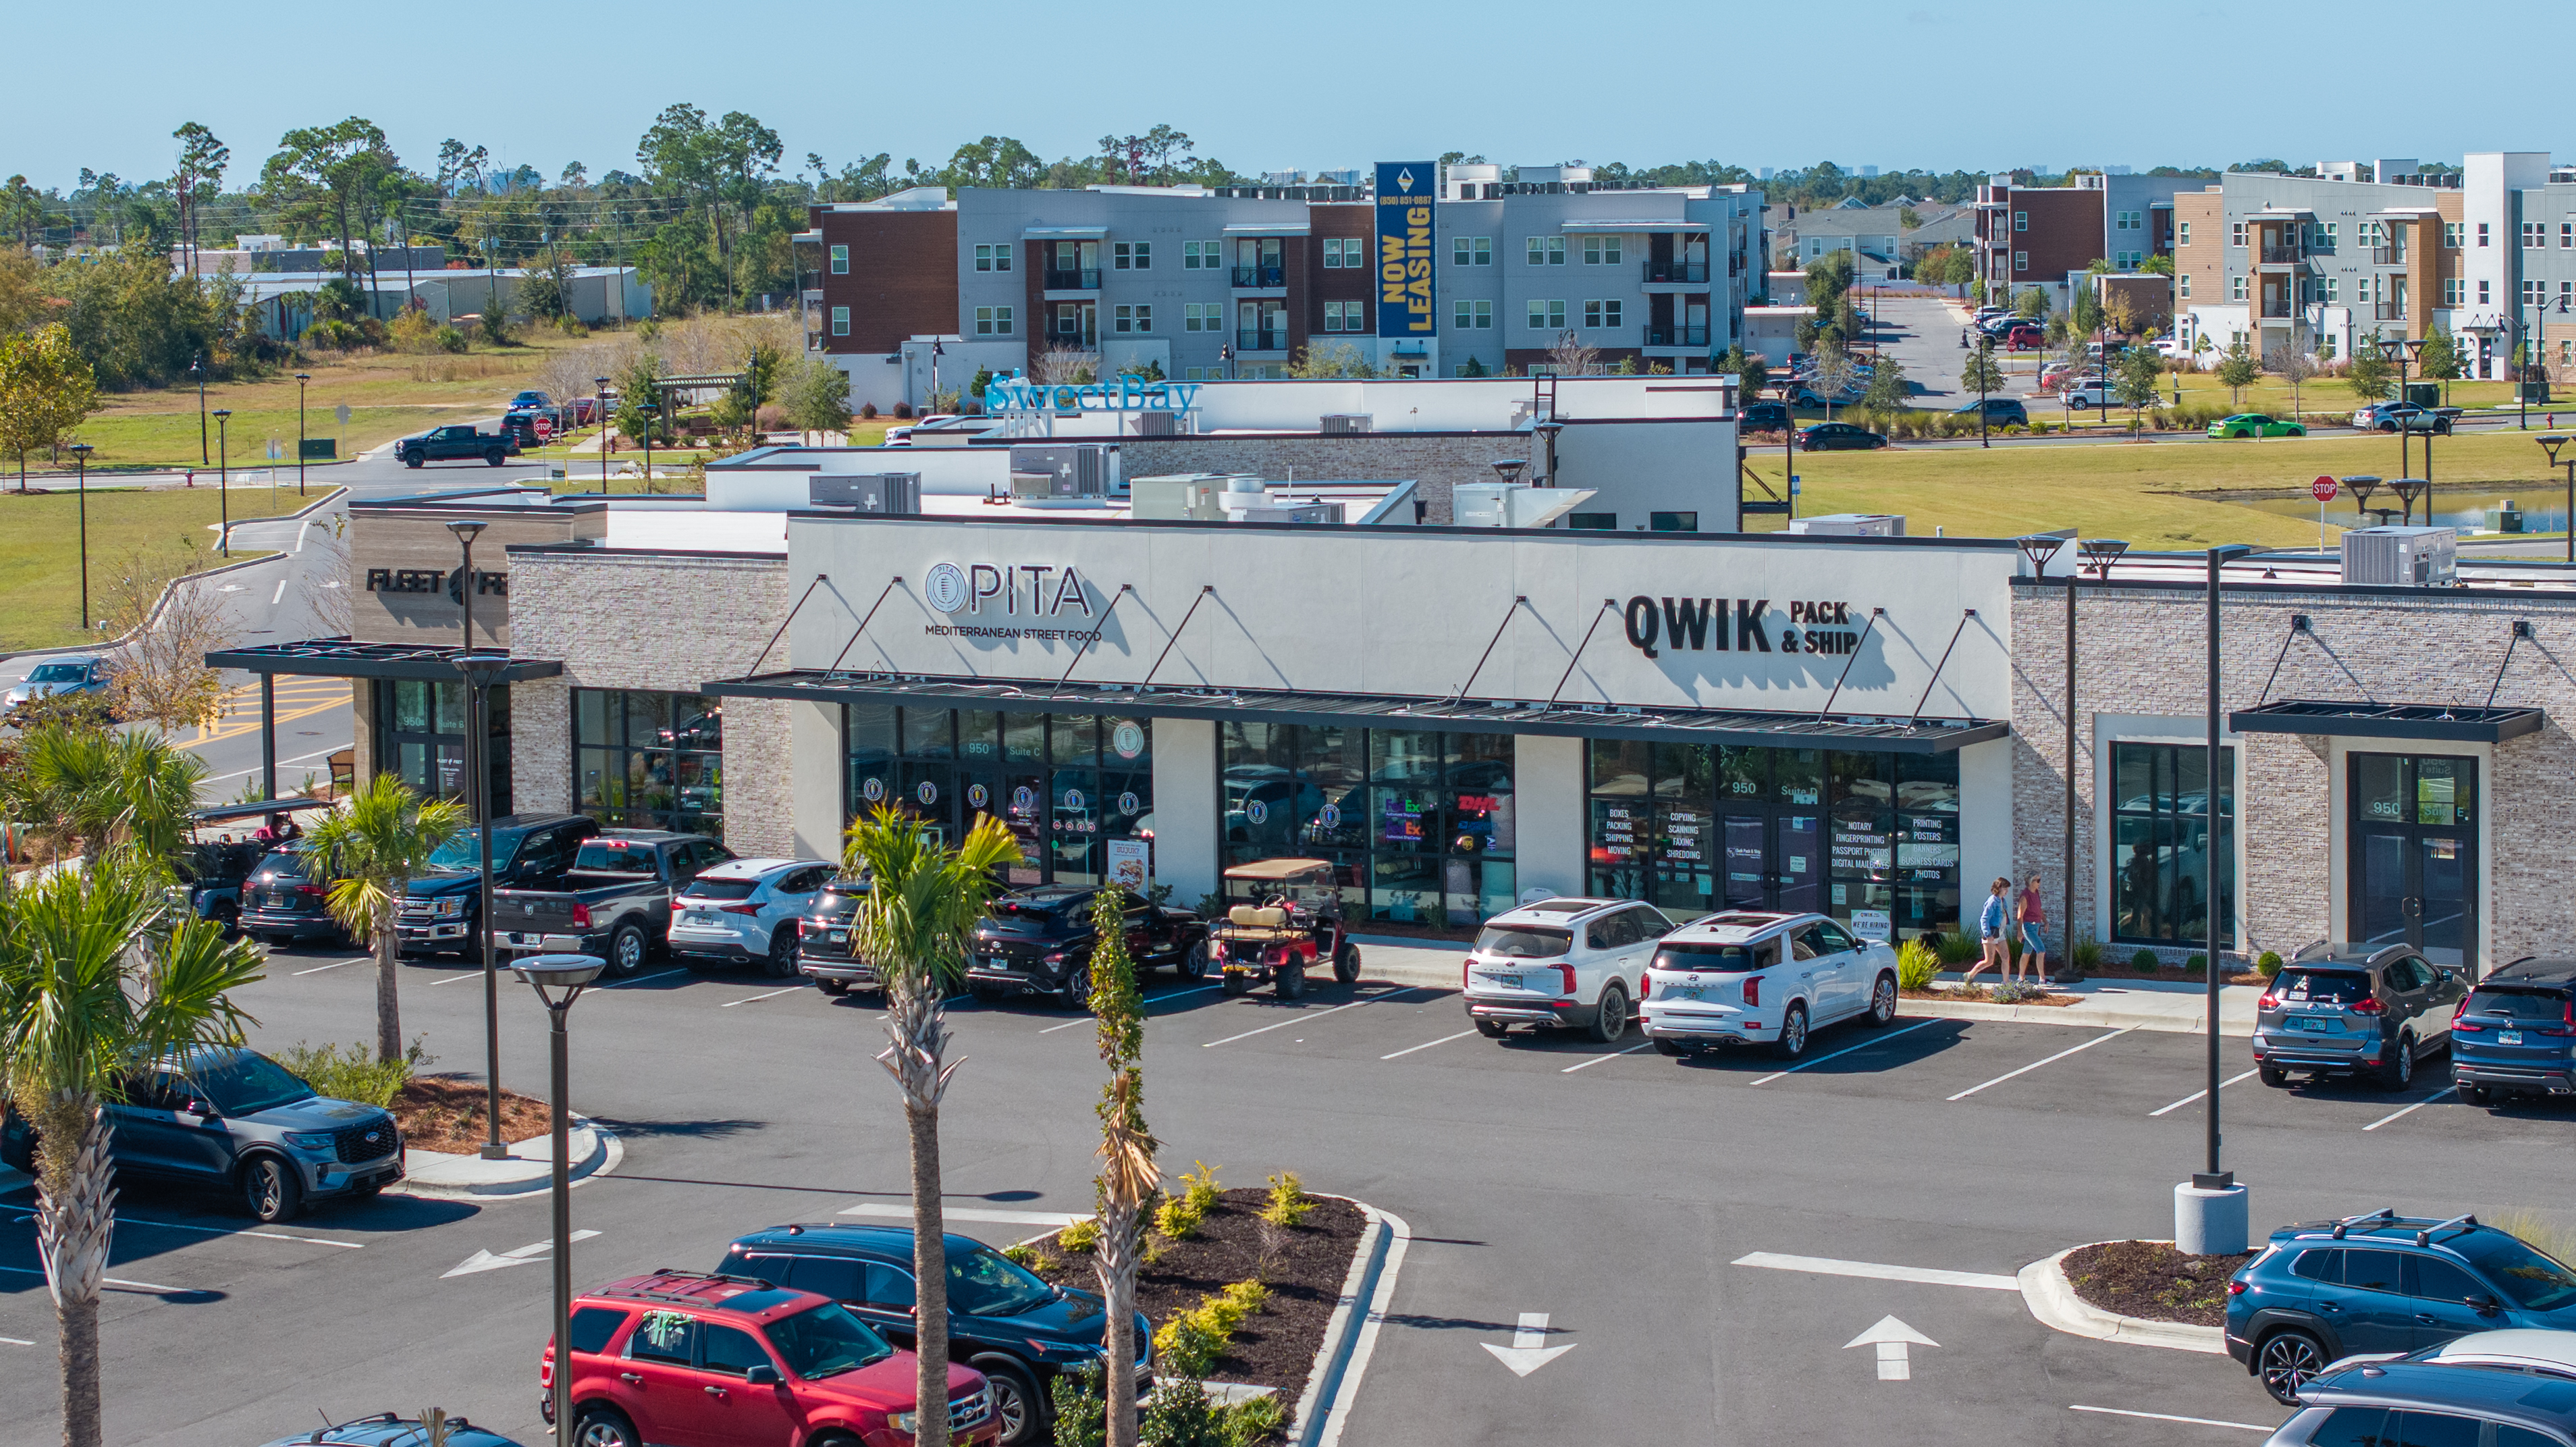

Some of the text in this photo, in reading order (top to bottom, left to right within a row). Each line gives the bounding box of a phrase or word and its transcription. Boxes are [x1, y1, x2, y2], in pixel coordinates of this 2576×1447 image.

[1380, 195, 1432, 205] (850) 851-0887
[1382, 234, 1406, 303] NOW
[1406, 207, 1432, 331] LEASING
[989, 374, 1200, 419] SweetBay
[535, 423, 551, 431] STOP
[2314, 483, 2336, 494] STOP
[938, 566, 953, 575] PITA
[367, 569, 446, 593] FLEET
[970, 563, 1094, 617] PITA
[1790, 600, 1849, 625] PACK
[1625, 595, 1772, 658] QWIK
[925, 625, 1102, 641] MEDITERRANEAN STREET FOOD
[1781, 629, 1858, 654] & SHIP
[404, 716, 421, 727] 950
[438, 720, 456, 728] Suite
[969, 743, 1040, 756] 950 Suite C
[1732, 781, 1818, 795] 950 Suite D
[1386, 799, 1420, 812] FedEx
[1458, 795, 1501, 811] DHL
[1609, 809, 1629, 818] BOXES
[2373, 801, 2400, 814] 950
[2457, 807, 2464, 817] E
[1670, 812, 1696, 822] COPYING
[1386, 820, 1421, 835] FedEx
[1606, 821, 1632, 831] PACKING
[1848, 822, 1872, 831] NOTARY
[1913, 818, 1942, 828] PRINTING
[1668, 824, 1698, 835] SCANNING
[1605, 833, 1634, 843] SHIPPING
[1835, 833, 1885, 844] FINGERPRINTING
[1913, 831, 1941, 841] POSTERS
[1673, 837, 1694, 847] FAXING
[1607, 845, 1632, 855] MOVING
[1667, 849, 1700, 860] SHREDDING
[1832, 845, 1889, 857] PASSPORT PHOTOS
[1913, 844, 1942, 854] BANNERS
[1831, 858, 1889, 870] DIGITAL MAILBOXES
[1901, 856, 1954, 867] BUSINESS CARDS
[1915, 869, 1940, 879] PHOTOS
